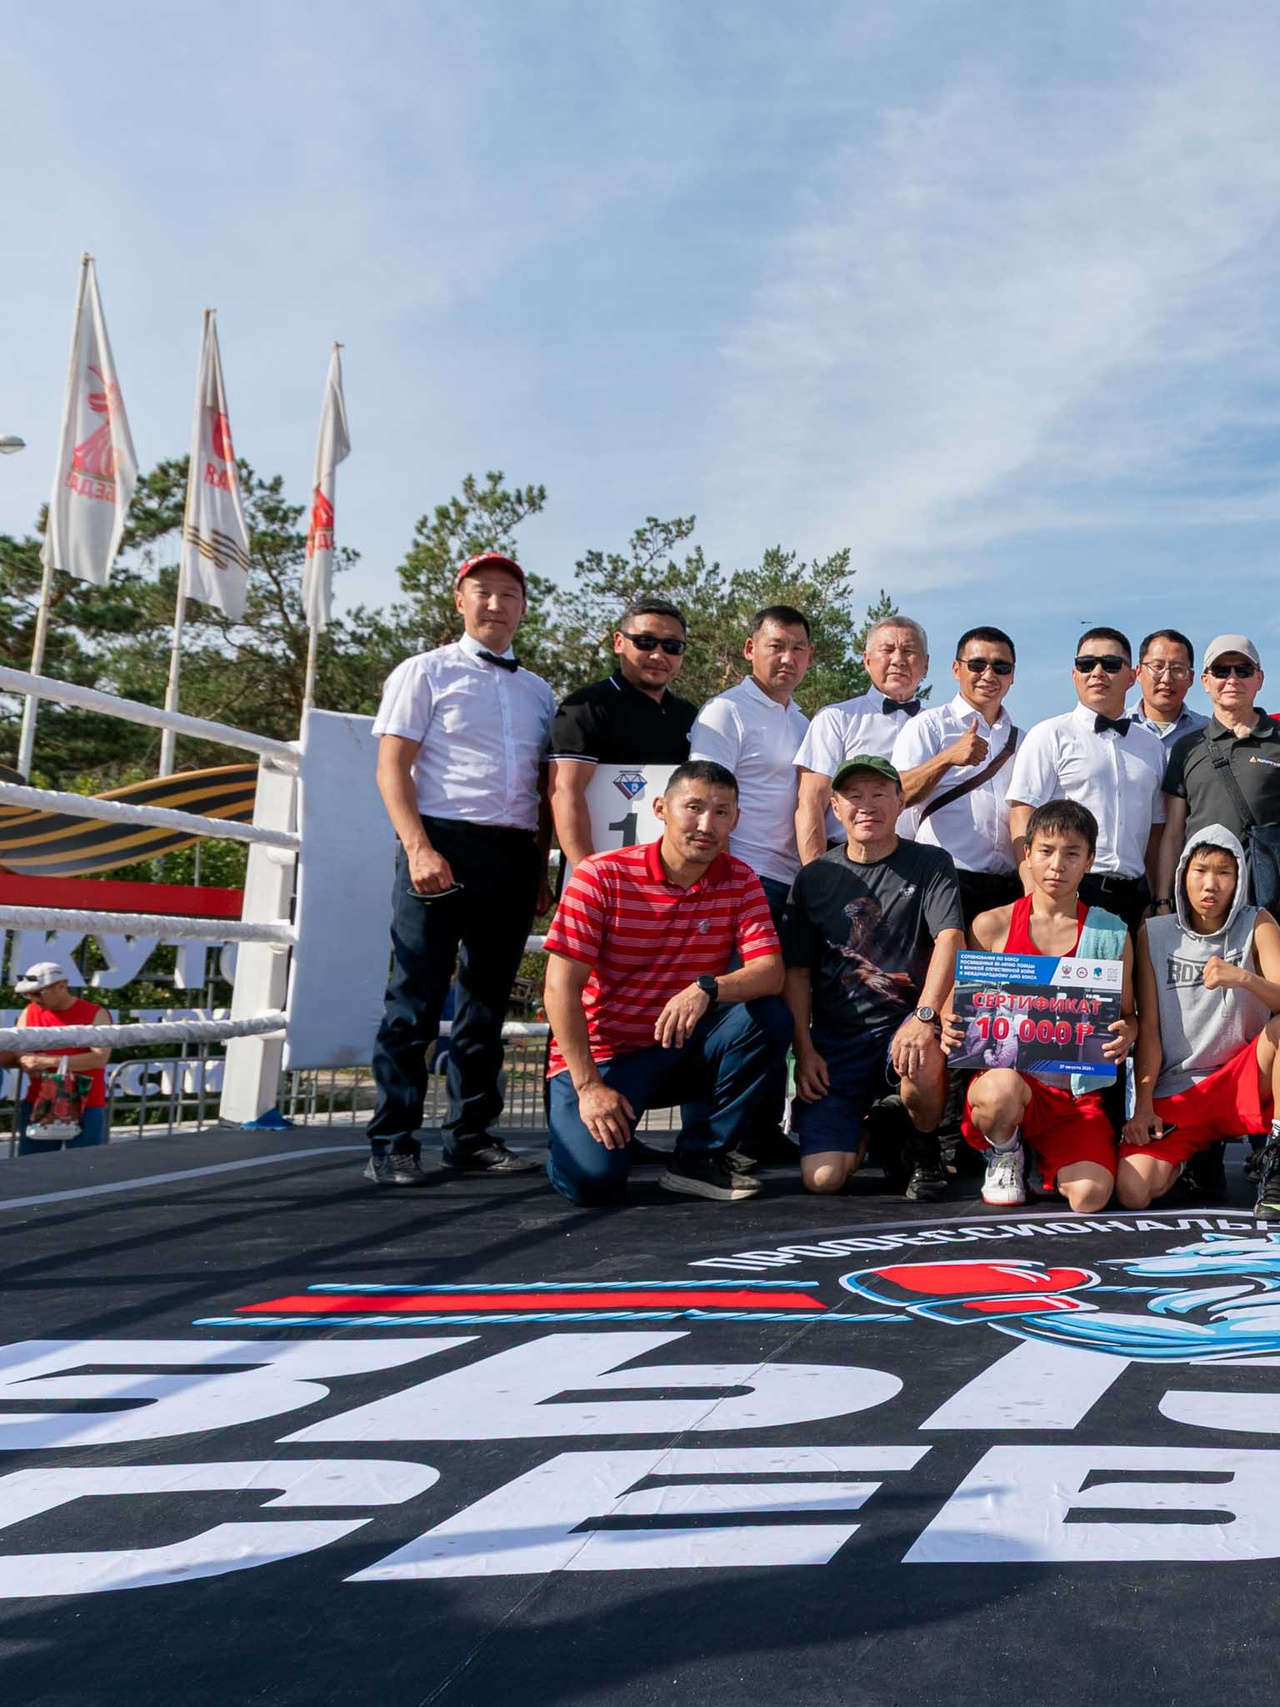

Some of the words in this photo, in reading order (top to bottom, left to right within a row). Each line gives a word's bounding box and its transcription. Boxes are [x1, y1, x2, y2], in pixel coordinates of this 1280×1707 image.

[608, 813, 638, 848] 1
[972, 992, 1102, 1014] СЕРТИФИКАТ
[976, 1017, 1010, 1041] 10
